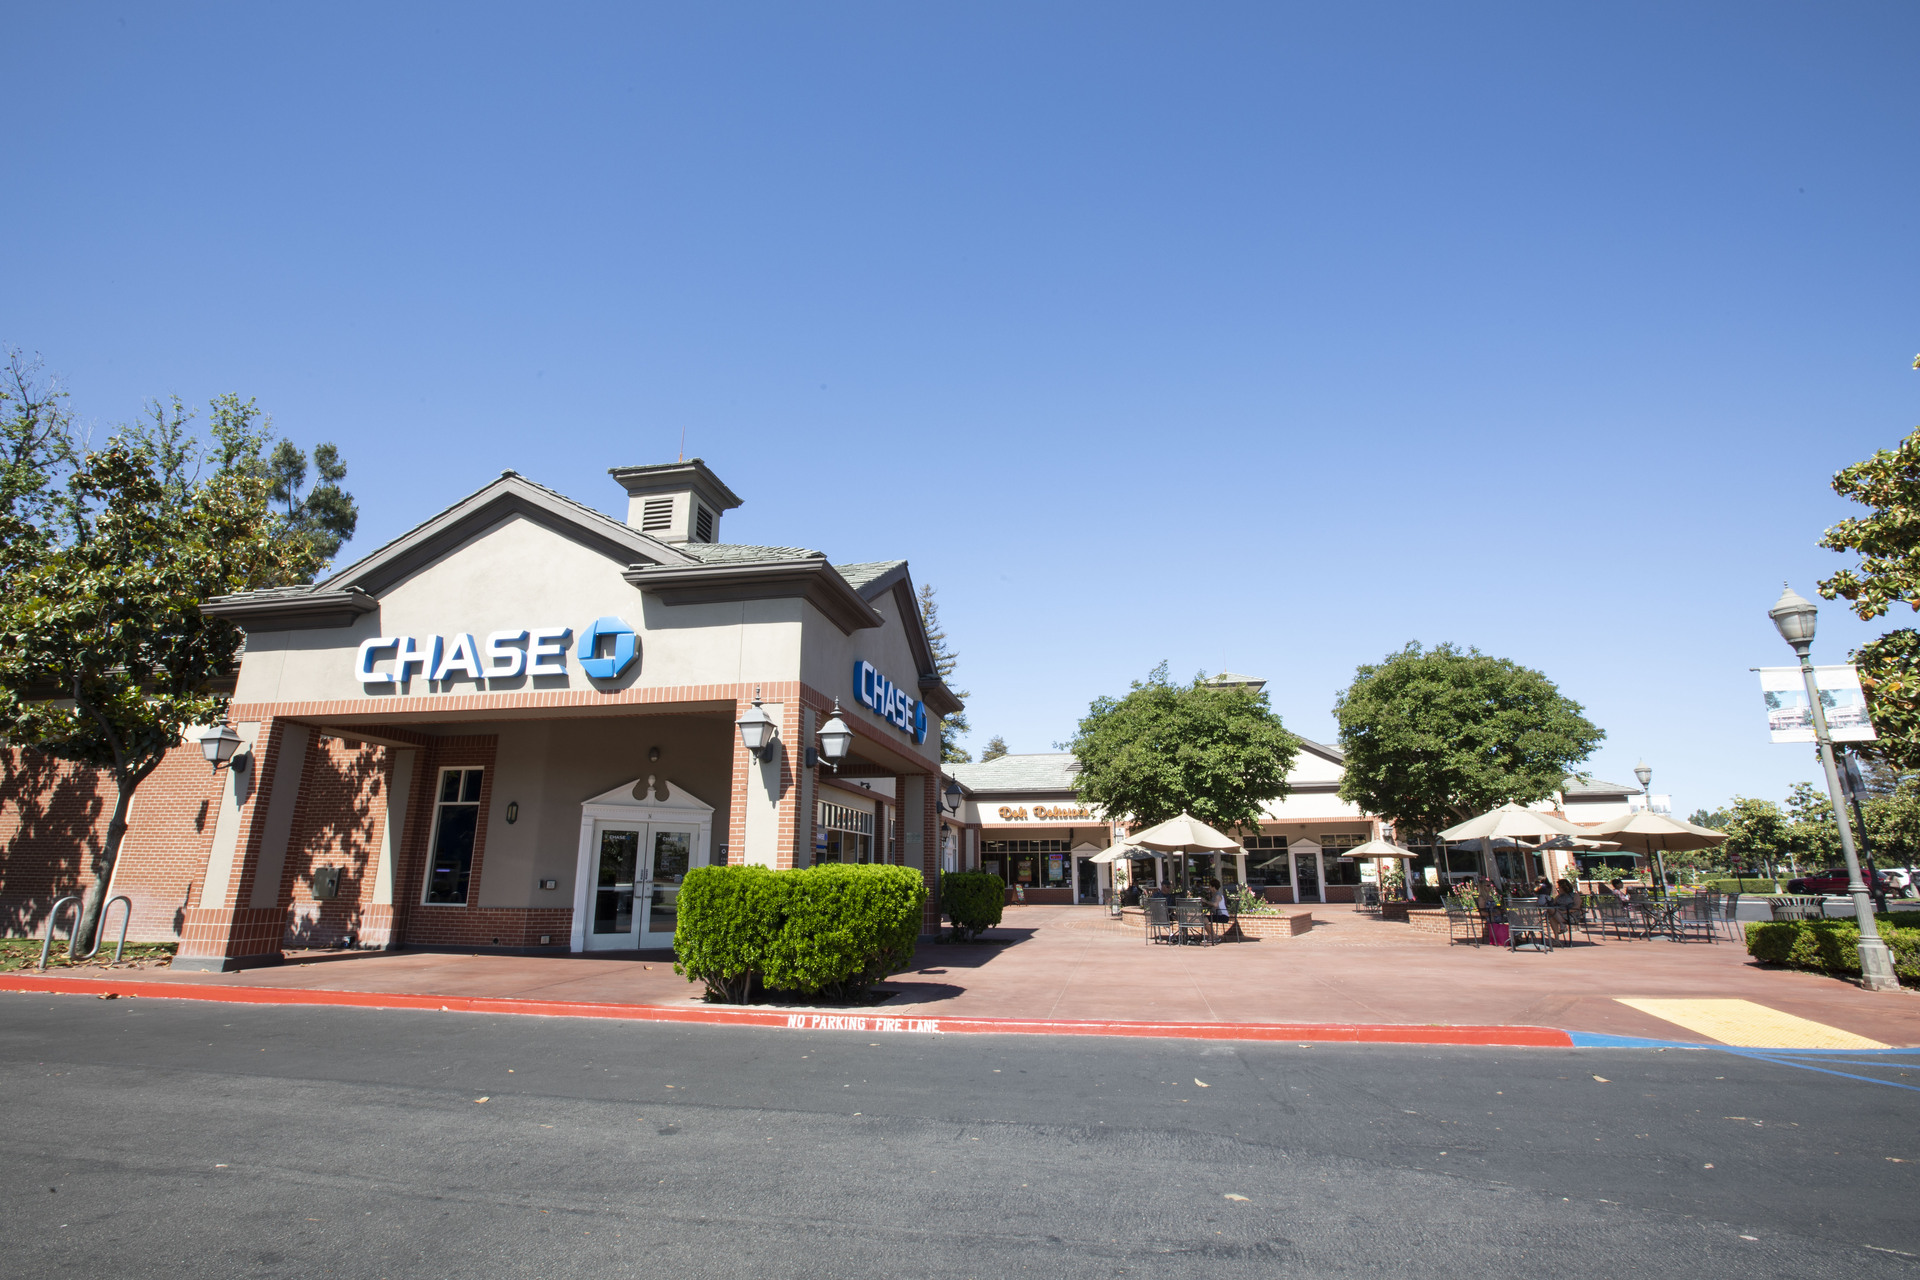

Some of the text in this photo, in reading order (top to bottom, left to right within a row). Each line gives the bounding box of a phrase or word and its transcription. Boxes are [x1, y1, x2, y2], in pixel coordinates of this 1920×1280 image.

[355, 627, 573, 682] CHASE
[857, 660, 914, 735] CHASE
[787, 1014, 940, 1033] NO PARKING FIRE LANE
